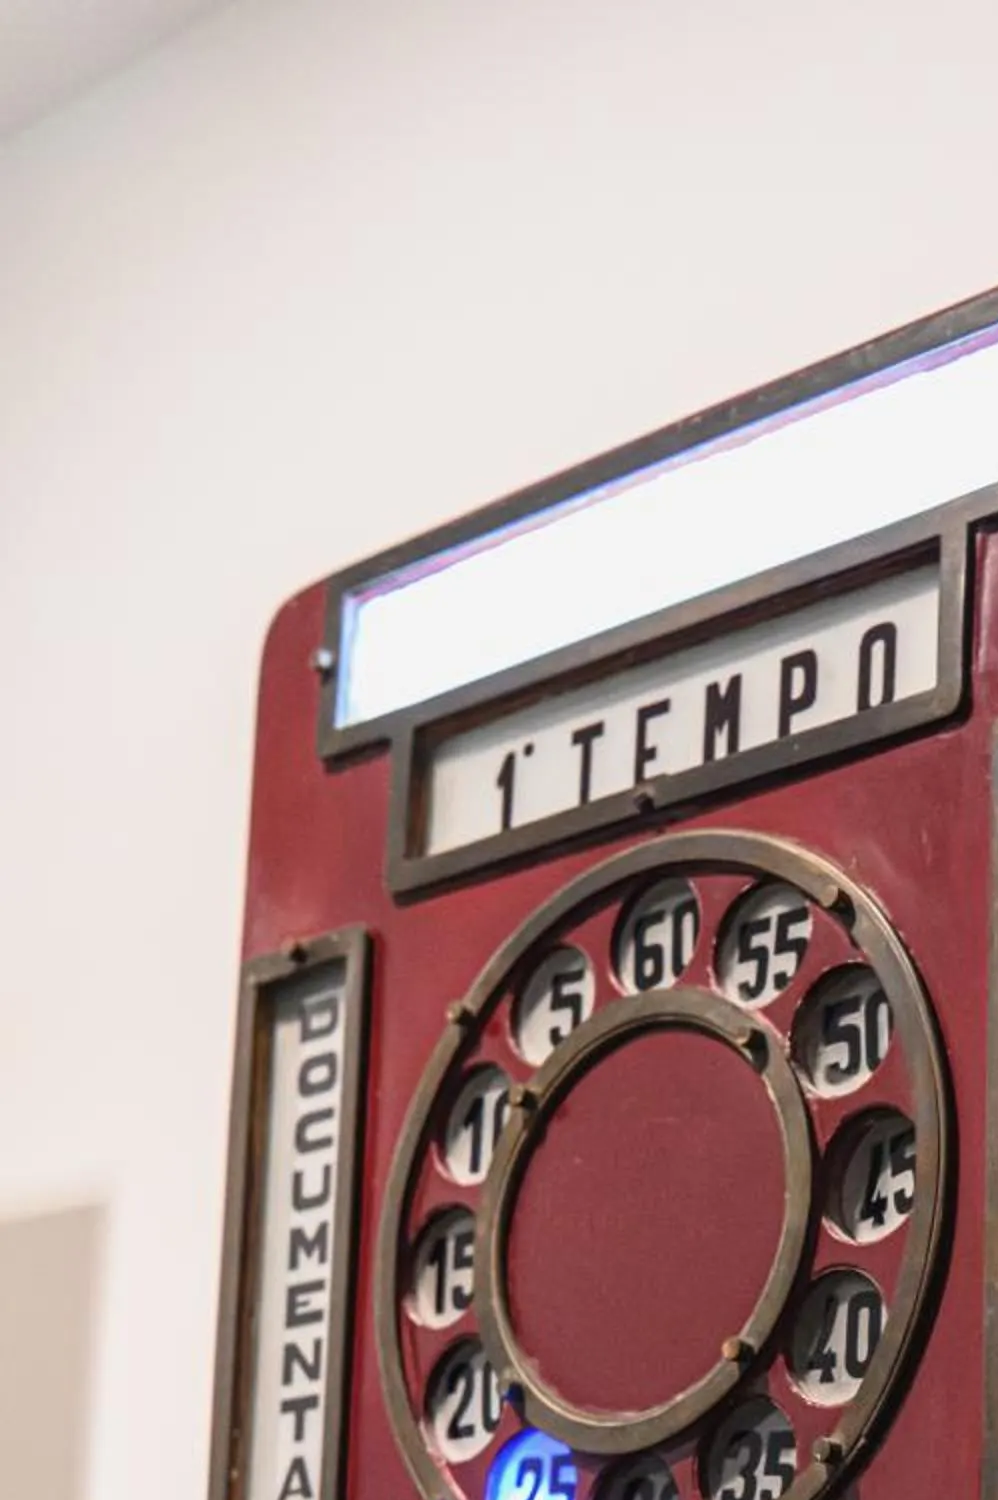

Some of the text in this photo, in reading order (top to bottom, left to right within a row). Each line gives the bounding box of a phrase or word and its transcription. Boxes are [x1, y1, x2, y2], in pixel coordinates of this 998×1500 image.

[571, 620, 897, 803] TEMPO
[634, 906, 698, 993] 60
[737, 908, 811, 999] 55
[548, 968, 584, 1047] 5
[825, 992, 893, 1083] 50
[860, 1128, 916, 1226] 45
[426, 1232, 475, 1314] 15
[808, 1290, 879, 1384] 40
